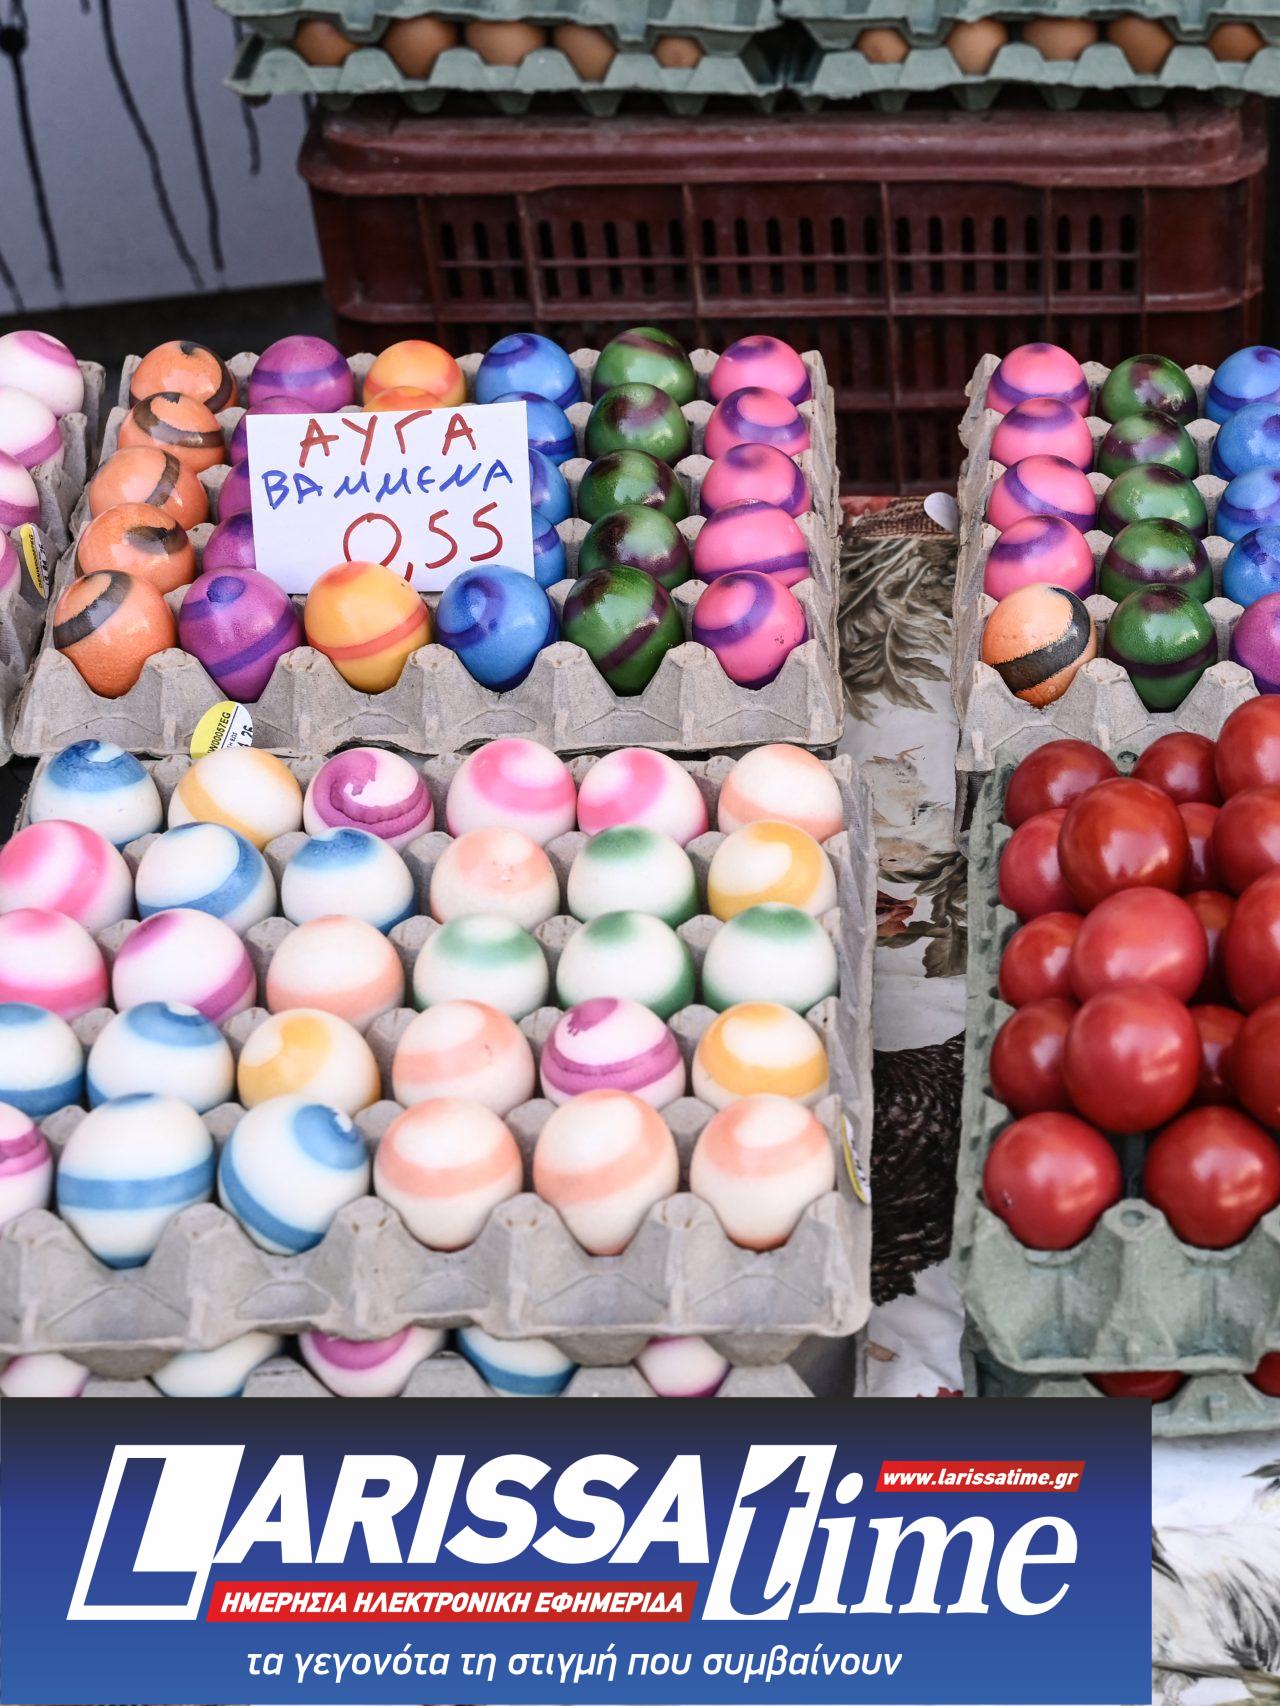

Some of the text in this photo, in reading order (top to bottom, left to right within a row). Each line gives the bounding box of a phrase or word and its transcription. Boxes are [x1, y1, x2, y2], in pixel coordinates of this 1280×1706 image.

[298, 409, 477, 468] ΑΥΓΑ
[261, 458, 513, 510] ΒΑΜΜΕΝΑ
[342, 501, 504, 583] 0,55
